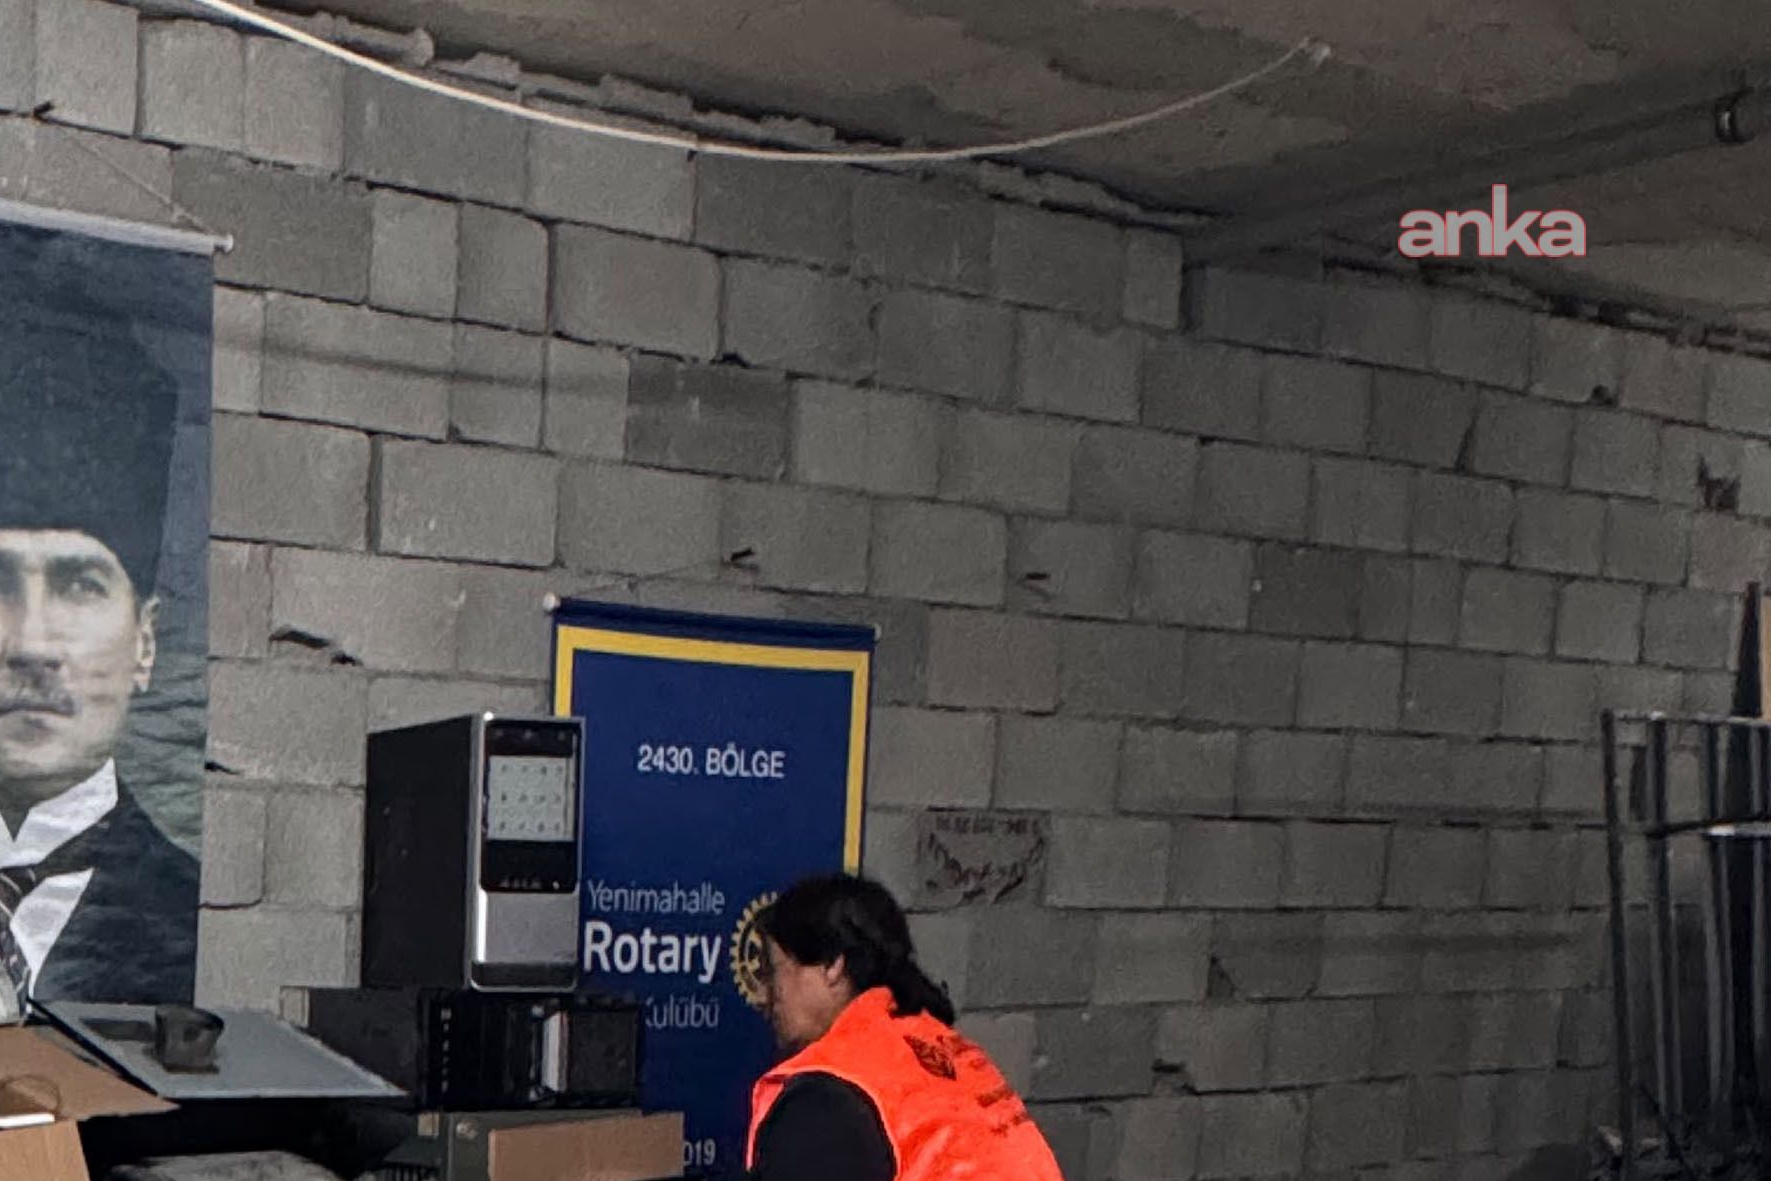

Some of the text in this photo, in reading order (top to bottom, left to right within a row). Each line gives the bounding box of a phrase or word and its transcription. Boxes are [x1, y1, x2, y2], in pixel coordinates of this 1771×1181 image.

[636, 741, 787, 779] 2430. BÖLGE
[586, 879, 726, 915] Yenimahalle
[582, 919, 722, 985] Rotary
[682, 1137, 717, 1168] 019
